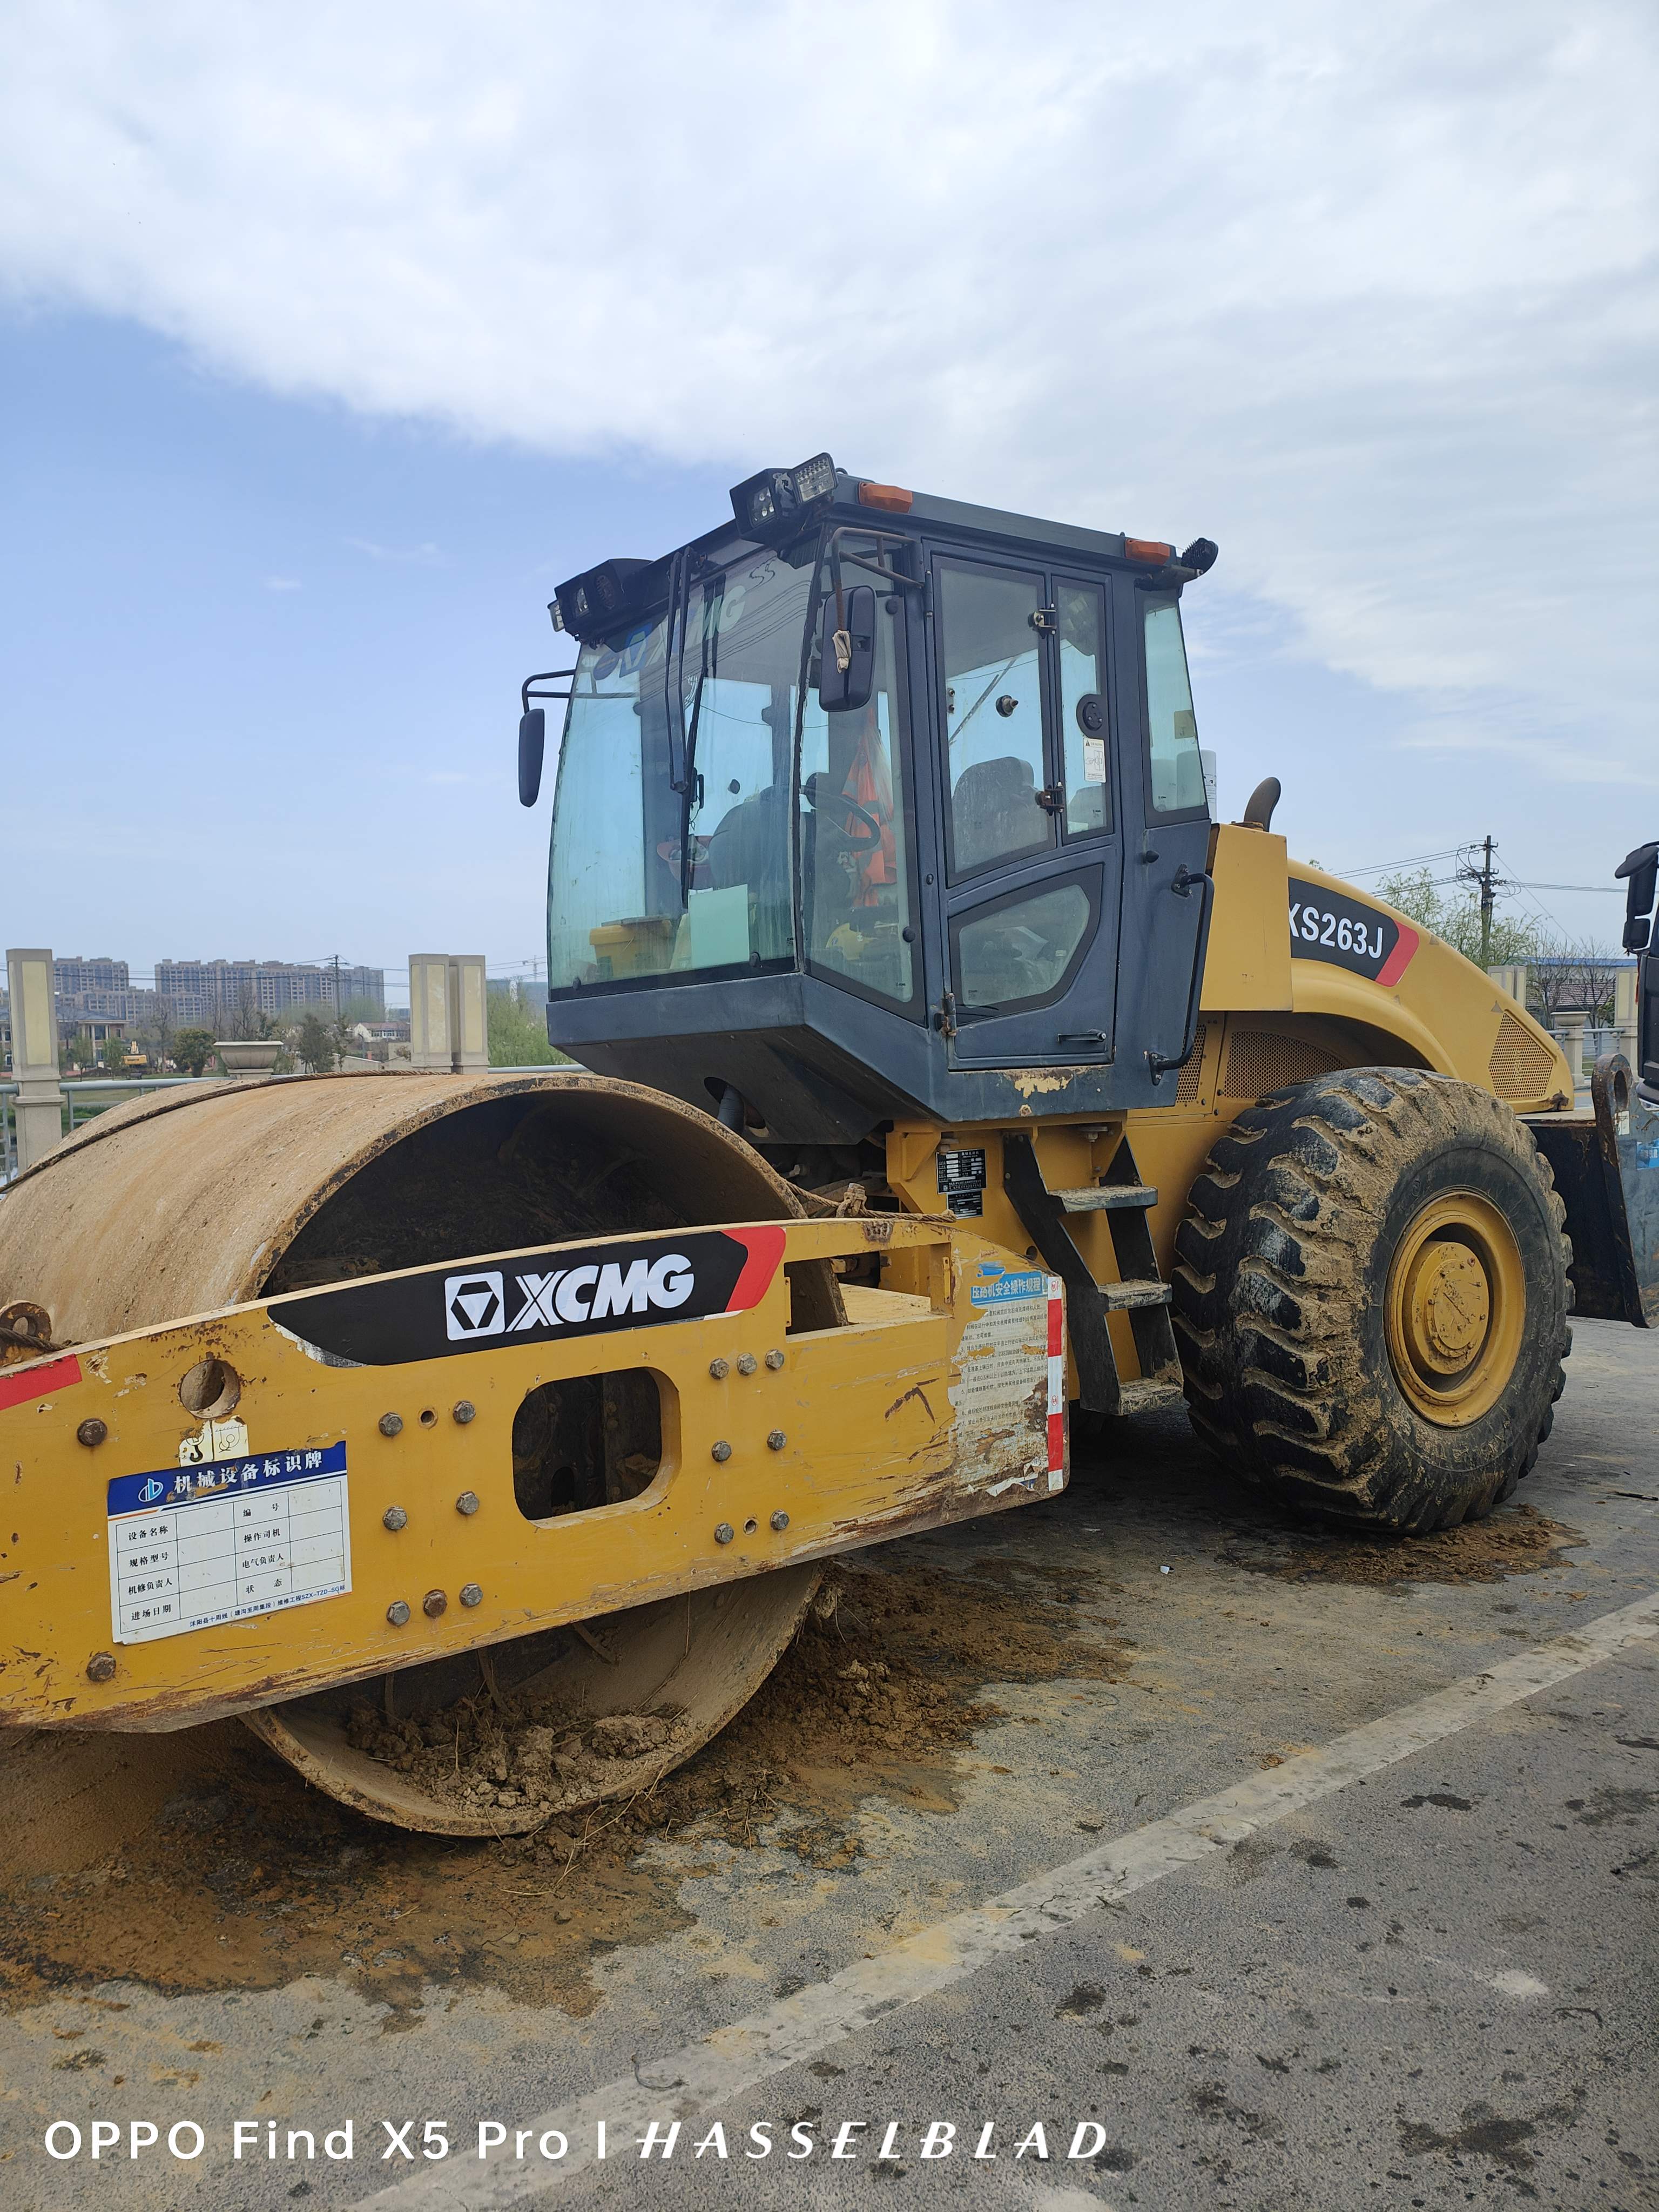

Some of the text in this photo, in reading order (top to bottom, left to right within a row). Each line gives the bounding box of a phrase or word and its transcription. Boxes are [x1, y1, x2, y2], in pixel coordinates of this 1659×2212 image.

[504, 1253, 694, 1332] XCMG
[173, 1449, 322, 1494] 机械设备标识牌
[128, 1525, 168, 1541] 设备名称
[243, 1528, 281, 1543] 操作司机
[129, 1552, 170, 1568] 规格型号
[241, 1552, 285, 1569] 电气负责人
[128, 1577, 173, 1595] 机修负责人
[131, 1604, 172, 1621] 进场日期
